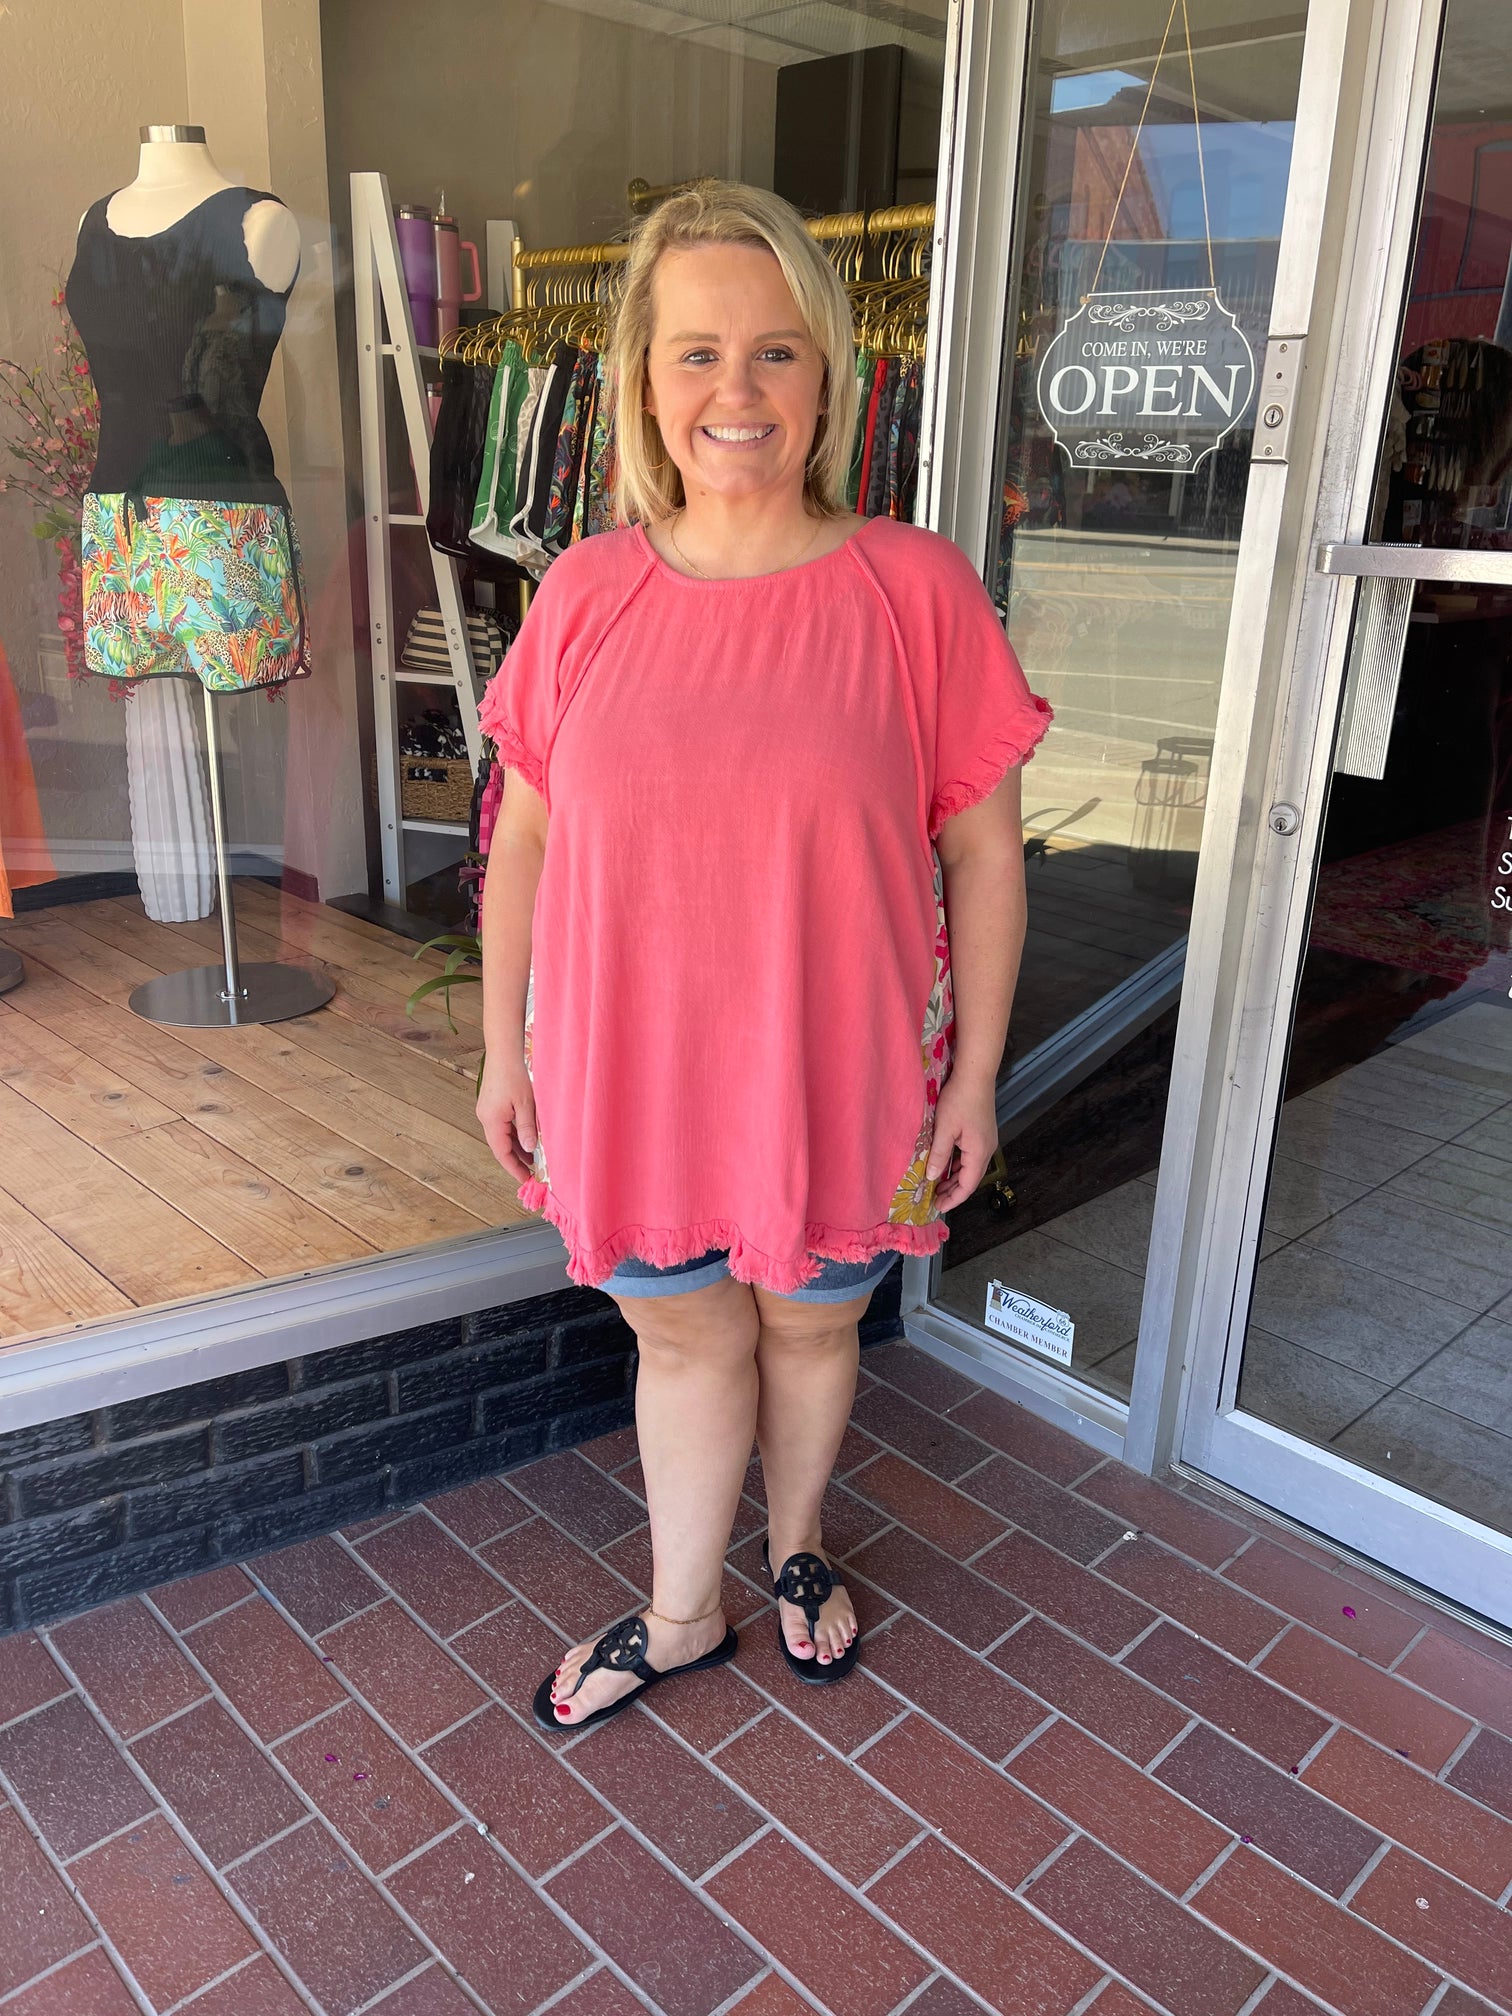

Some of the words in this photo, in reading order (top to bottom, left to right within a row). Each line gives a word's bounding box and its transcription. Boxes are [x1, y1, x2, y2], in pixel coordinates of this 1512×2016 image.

[1081, 341, 1127, 357] COME
[1131, 340, 1151, 359] IN,
[1156, 339, 1208, 356] WE'RE
[1049, 364, 1246, 418] OPEN
[988, 1314, 1029, 1339] CHAMBER
[1030, 1334, 1068, 1358] MEMBER
[999, 1289, 1072, 1337] Weatherford
